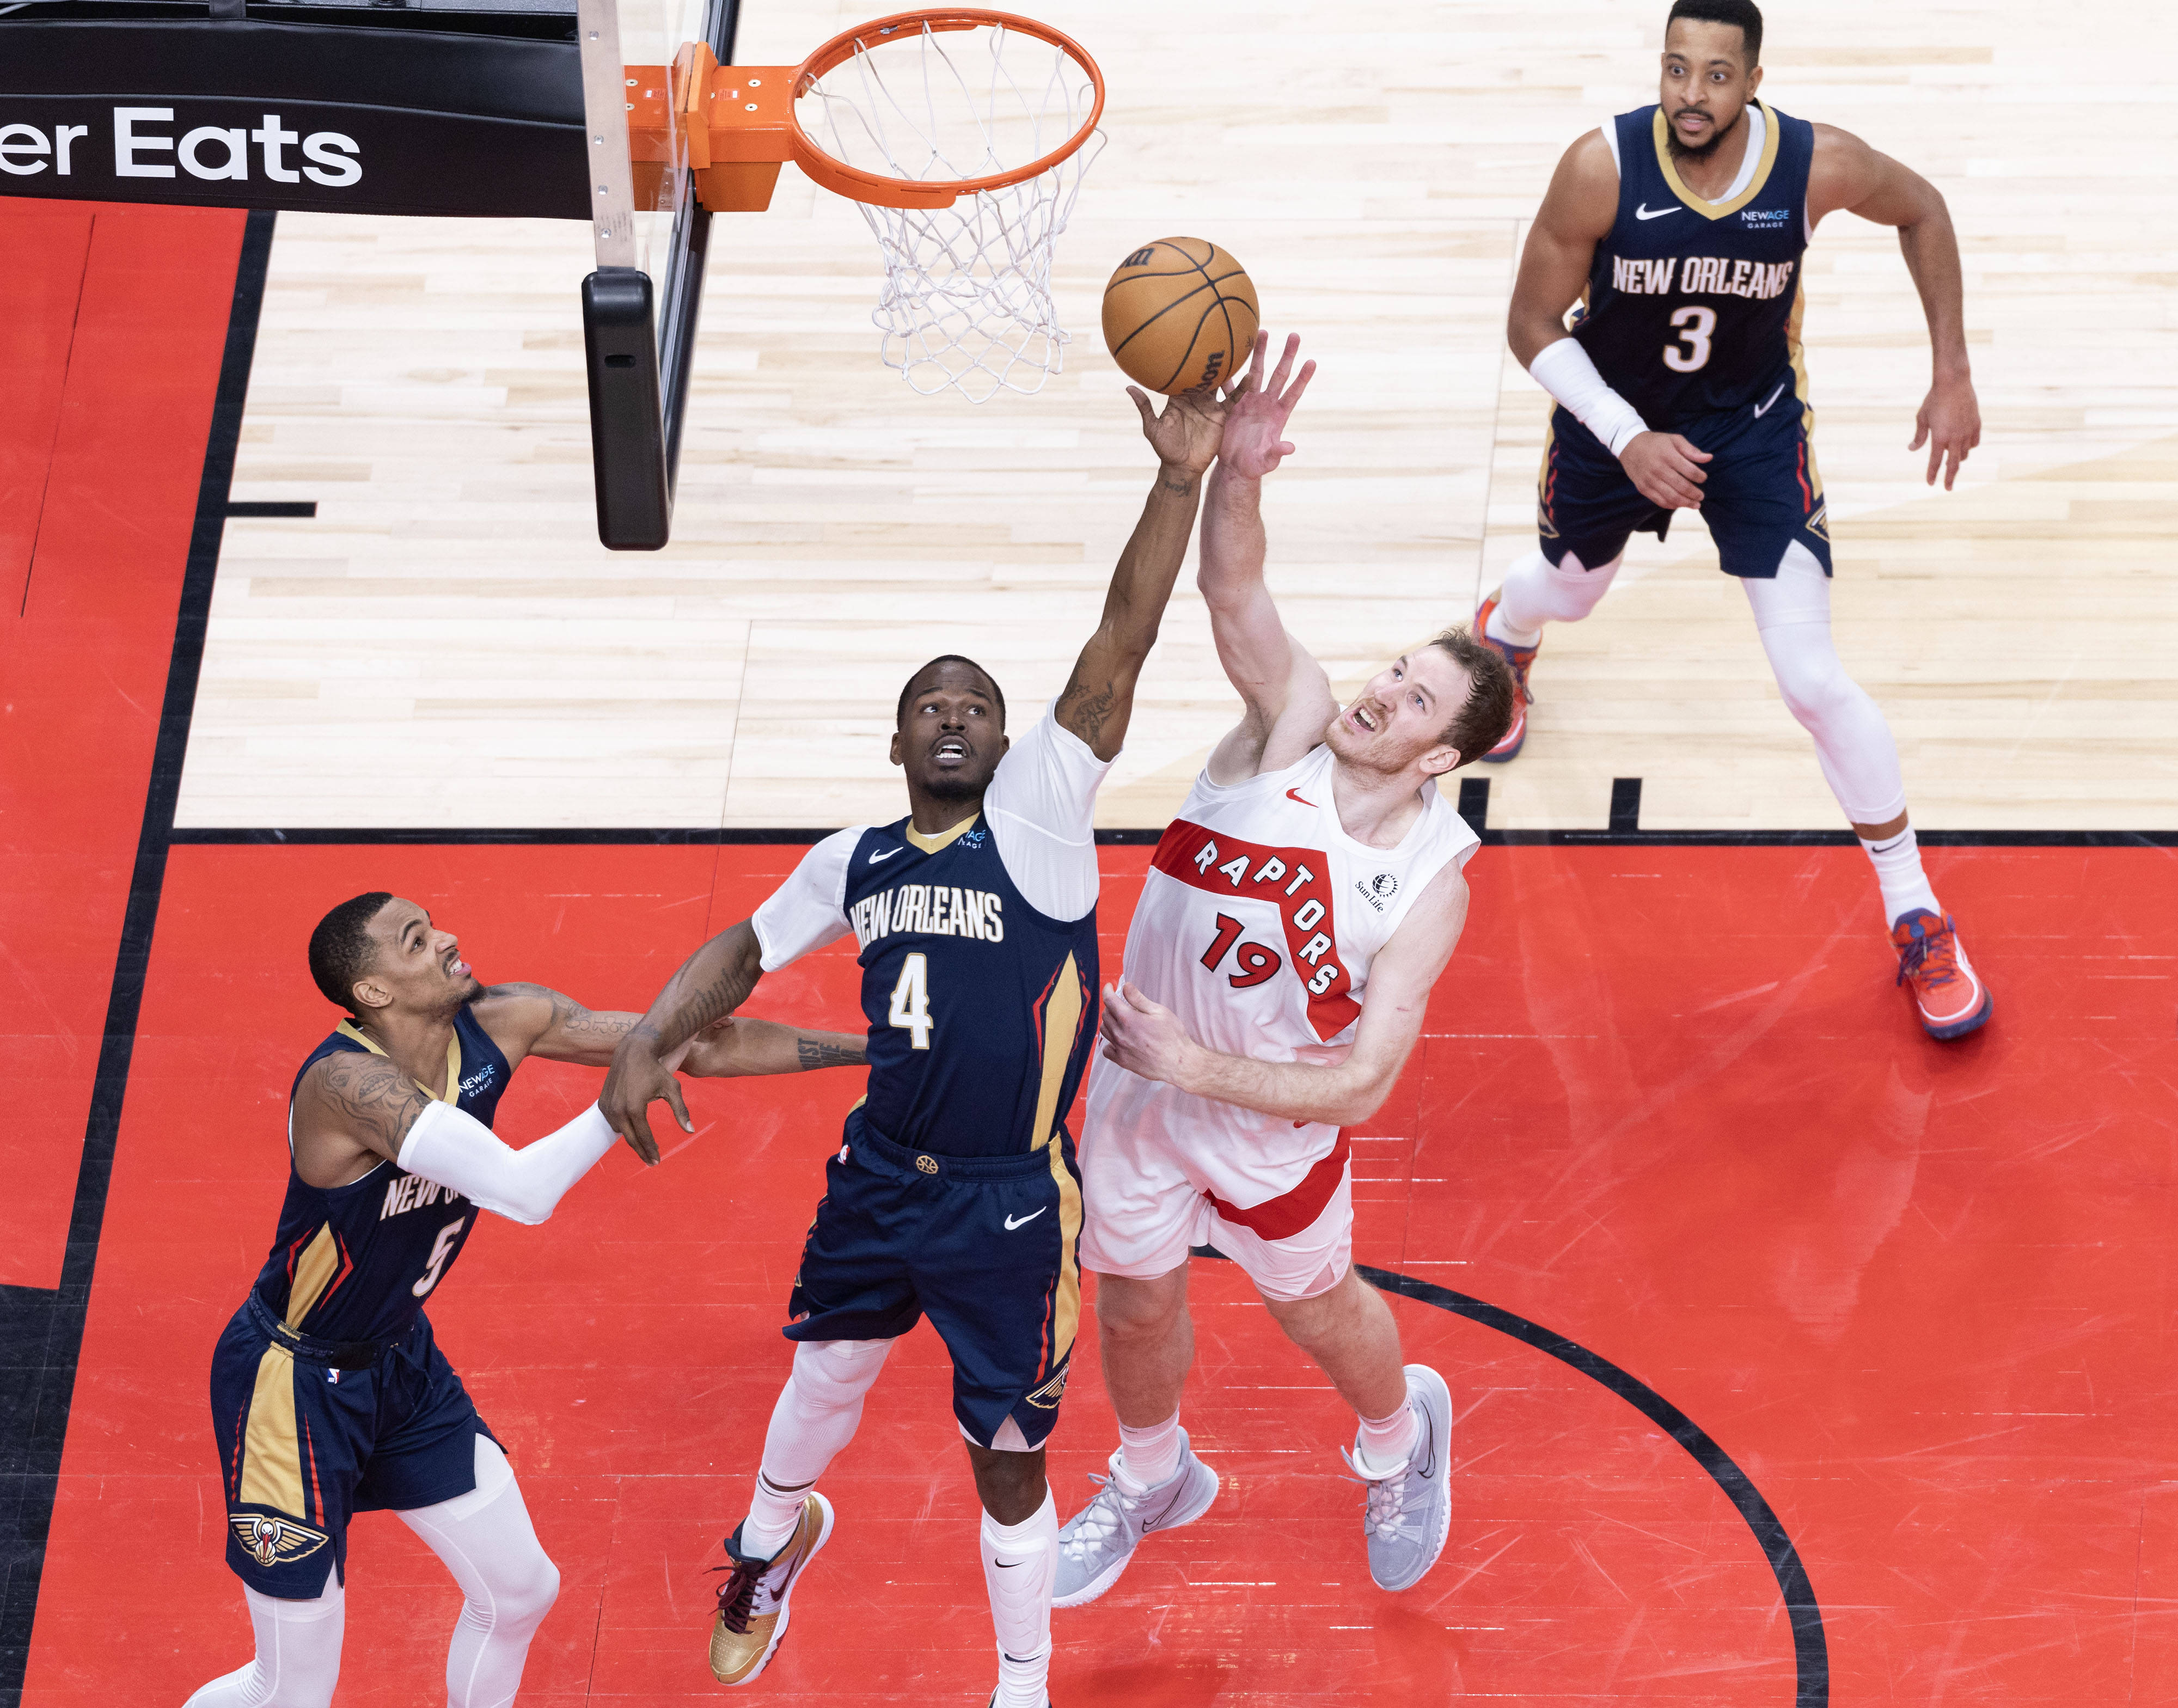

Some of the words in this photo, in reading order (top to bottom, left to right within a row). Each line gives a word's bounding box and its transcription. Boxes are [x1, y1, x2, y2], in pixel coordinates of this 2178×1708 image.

[0, 124, 88, 175] er
[114, 107, 363, 187] Eats
[1612, 255, 1677, 295] NEW
[1680, 257, 1794, 299] ORLEANS
[1662, 305, 1717, 373] 3
[849, 889, 894, 953] NEW
[891, 885, 1004, 942] ORLEANS
[1194, 837, 1339, 995] RAPTORS
[1355, 881, 1370, 898] Sun
[1368, 896, 1384, 913] Life
[1200, 912, 1282, 988] 19
[889, 952, 934, 1050] 4
[469, 1078, 493, 1097] GARAGE
[380, 1174, 441, 1221] NEW
[412, 1216, 466, 1297] 5
